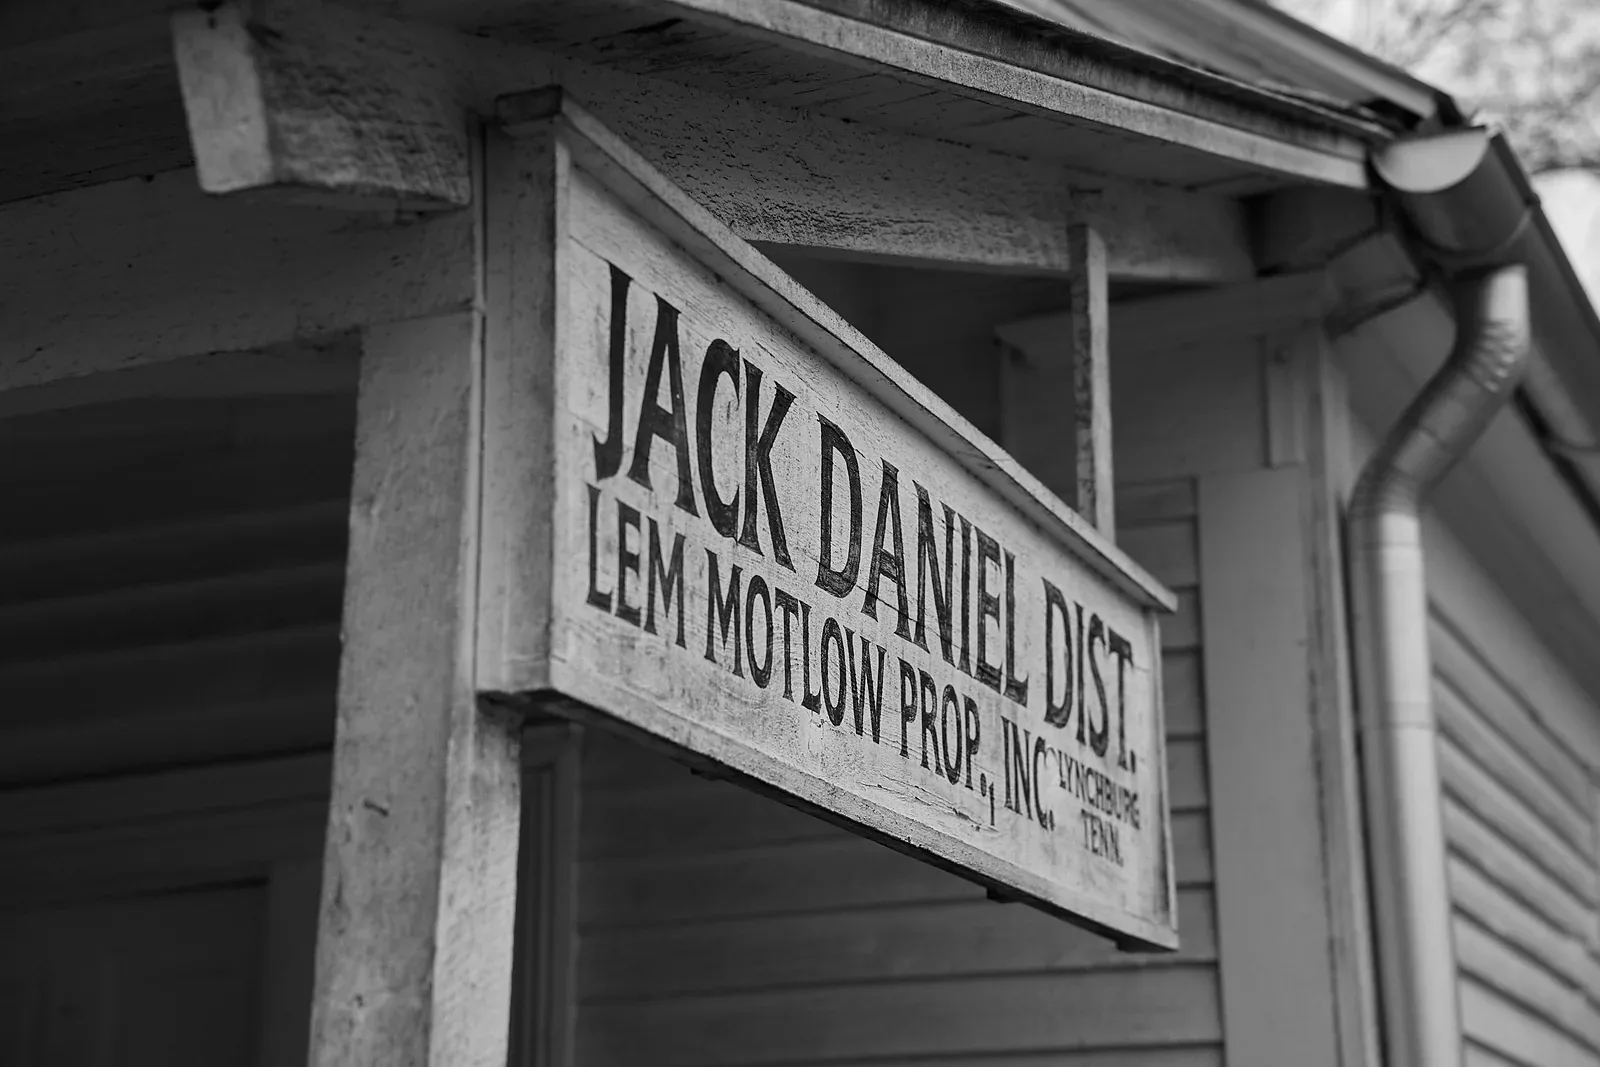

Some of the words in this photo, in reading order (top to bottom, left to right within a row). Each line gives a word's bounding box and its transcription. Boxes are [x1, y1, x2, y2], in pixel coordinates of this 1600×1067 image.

[586, 482, 688, 651] LEM
[704, 547, 887, 745] MOTLOW
[1001, 715, 1056, 832] INC.
[592, 260, 798, 574] JACK
[814, 410, 1029, 708] DANIEL
[1041, 576, 1137, 774] DIST.
[1057, 750, 1141, 830] LYNCHBURG
